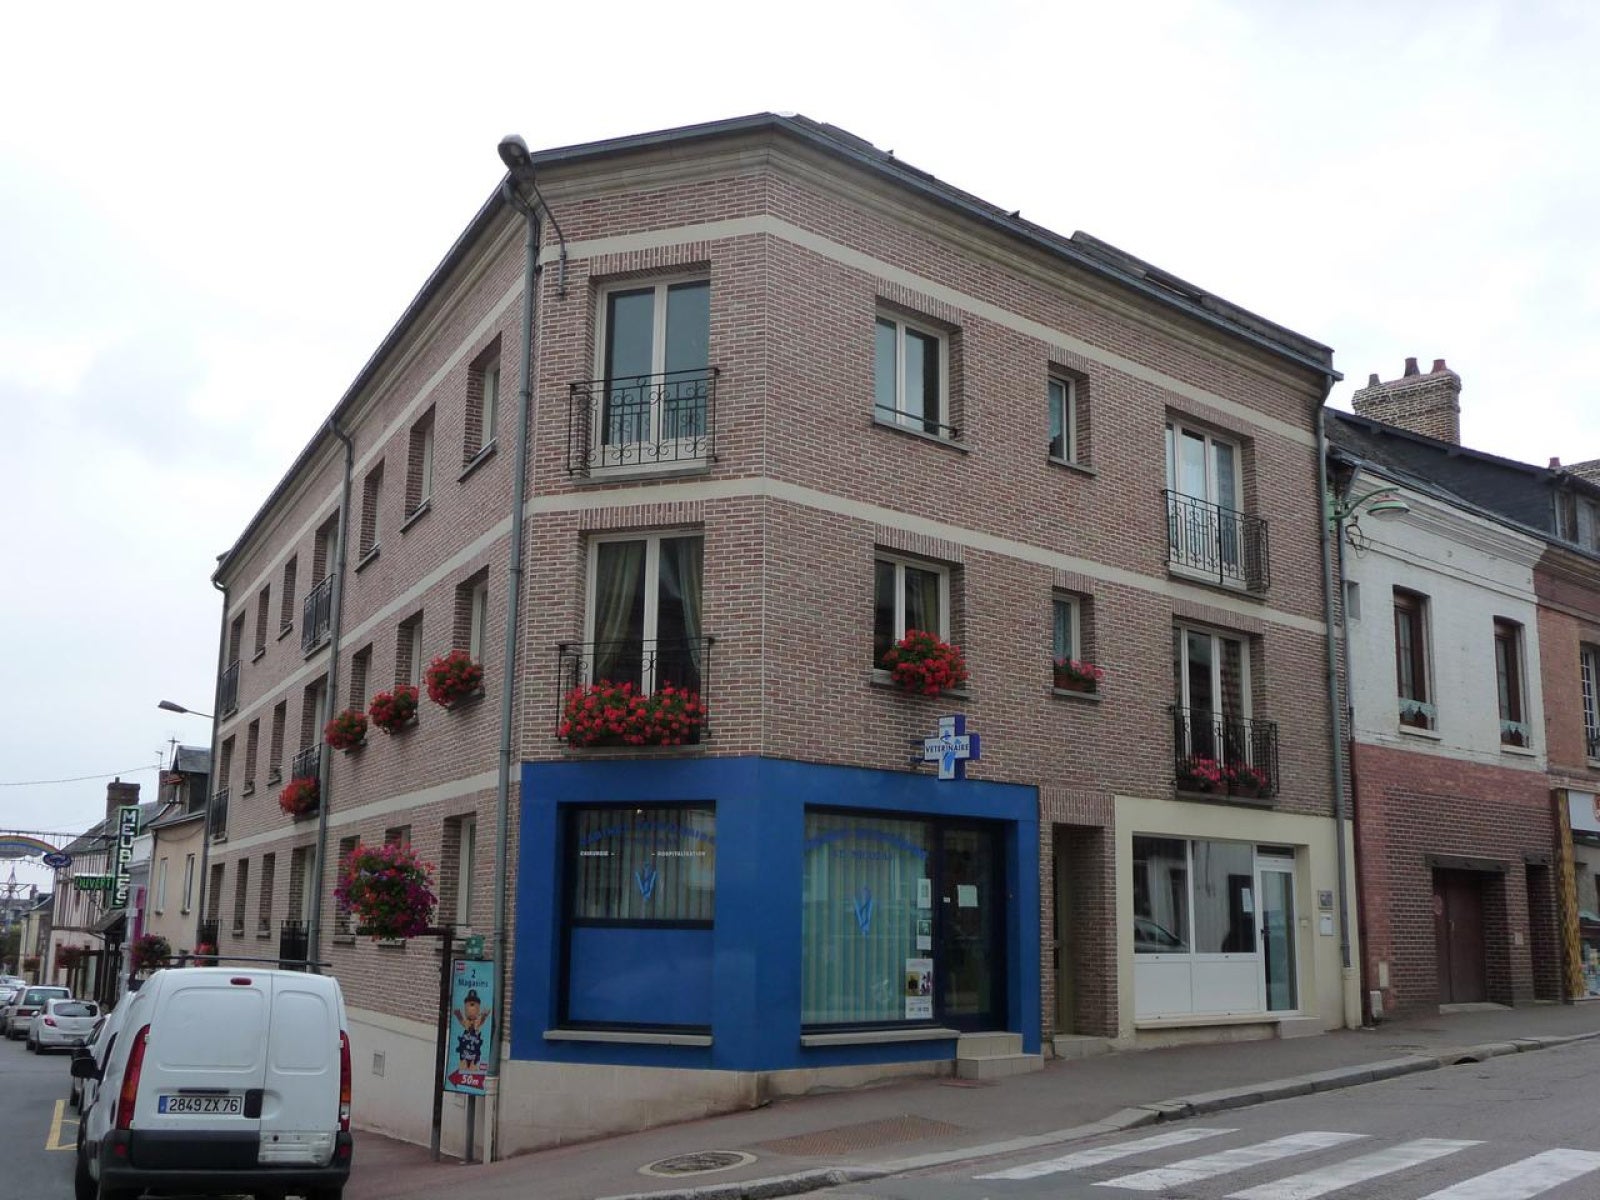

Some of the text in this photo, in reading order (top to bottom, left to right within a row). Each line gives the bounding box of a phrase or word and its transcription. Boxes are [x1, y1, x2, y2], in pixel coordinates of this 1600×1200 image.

[115, 810, 136, 905] MEUBLES
[169, 1098, 238, 1112] 2849 ZX 76
